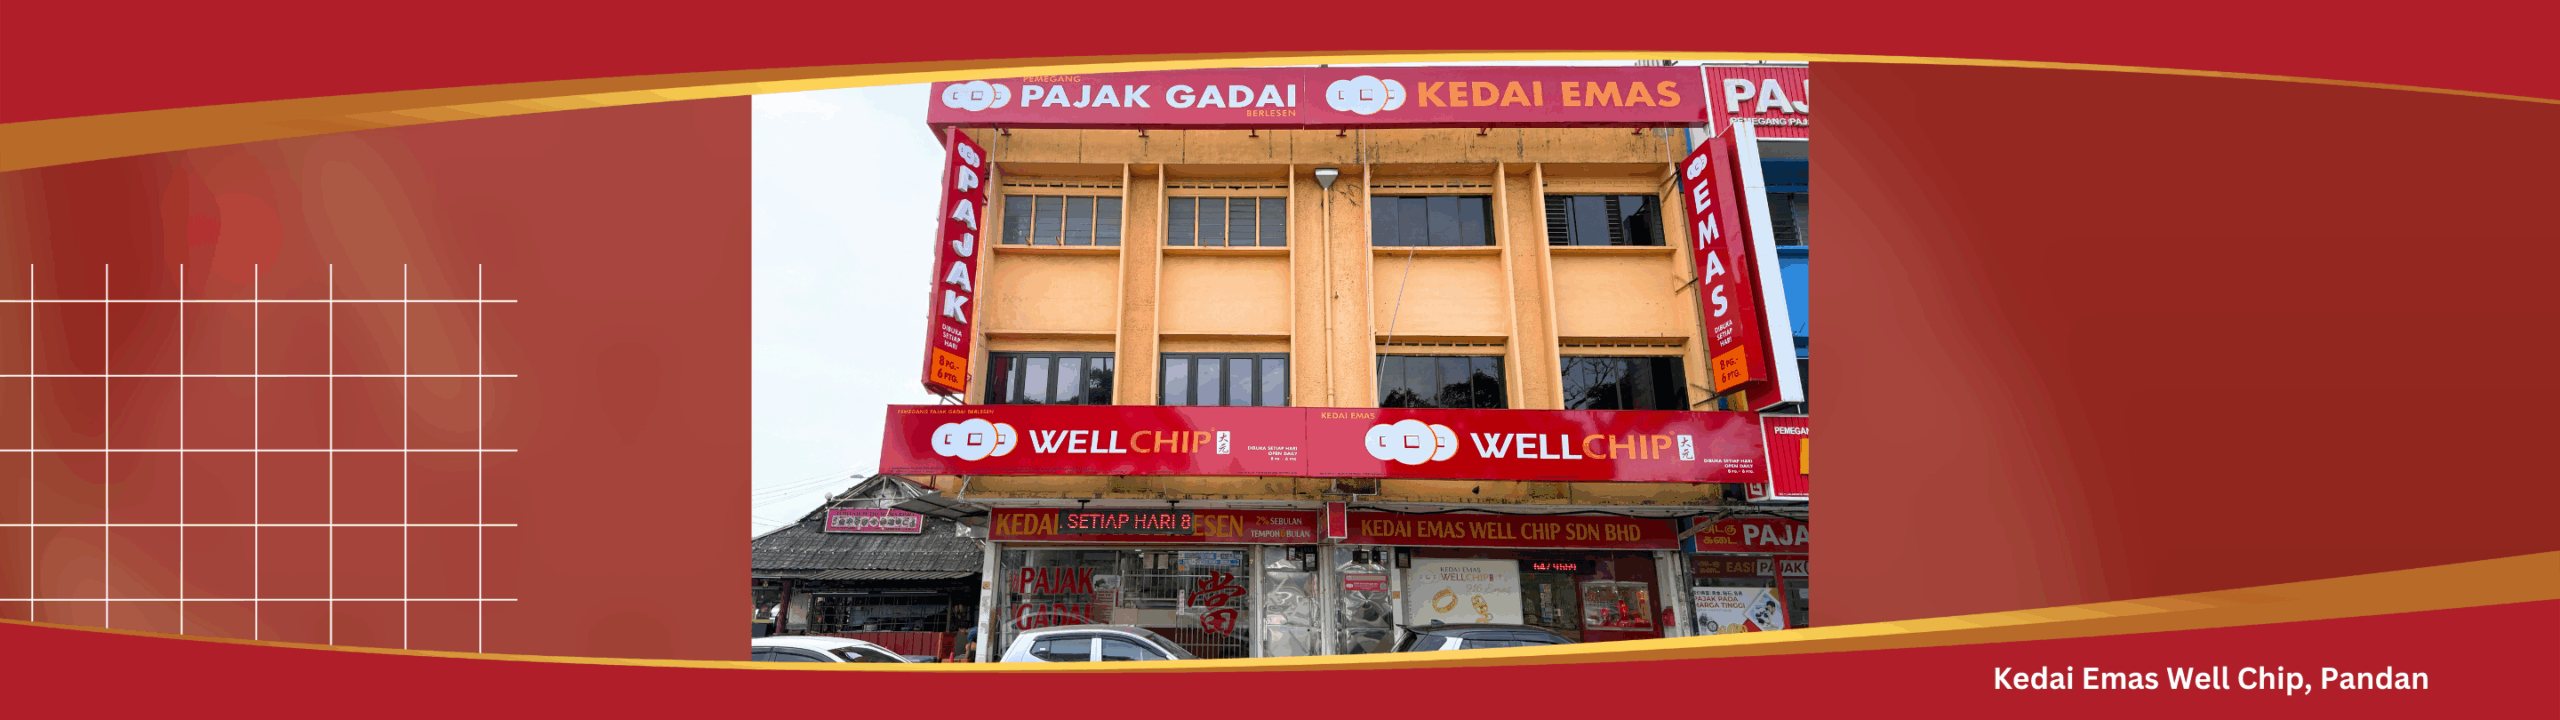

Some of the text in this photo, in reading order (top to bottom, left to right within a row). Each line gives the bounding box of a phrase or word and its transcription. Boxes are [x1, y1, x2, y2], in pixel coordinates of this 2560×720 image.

[1023, 75, 1081, 83] PEMEGANG
[1021, 84, 1296, 109] PAJAK GADAI
[1418, 80, 1681, 108] KEDAI EMAS
[1246, 109, 1296, 117] BERLESEN
[943, 164, 979, 324] PAJAK
[1693, 178, 1728, 317] EMAS
[943, 331, 961, 344] SETIAP
[944, 339, 958, 350] HARI
[939, 354, 945, 367] 8
[1719, 359, 1725, 370] 8
[937, 367, 943, 379] 6
[1721, 372, 1727, 383] 6
[1321, 411, 1376, 420] KEDAI EMAS
[996, 513, 1243, 538] KEDAI ESEN
[1067, 513, 1191, 530] SETIAP HARI 8
[1255, 515, 1303, 526] 2% SEBULAN
[1251, 529, 1311, 538] TEMPOH 6 BULAN
[1361, 519, 1641, 542] KEDAI EMAS WELL CHIP SDN BHD
[1726, 560, 1803, 574] EASI PAAK
[1019, 567, 1095, 595] PAJAK
[1465, 583, 1483, 593] 916
[1187, 569, 1247, 638] 當
[1016, 602, 1091, 631] GADAI
